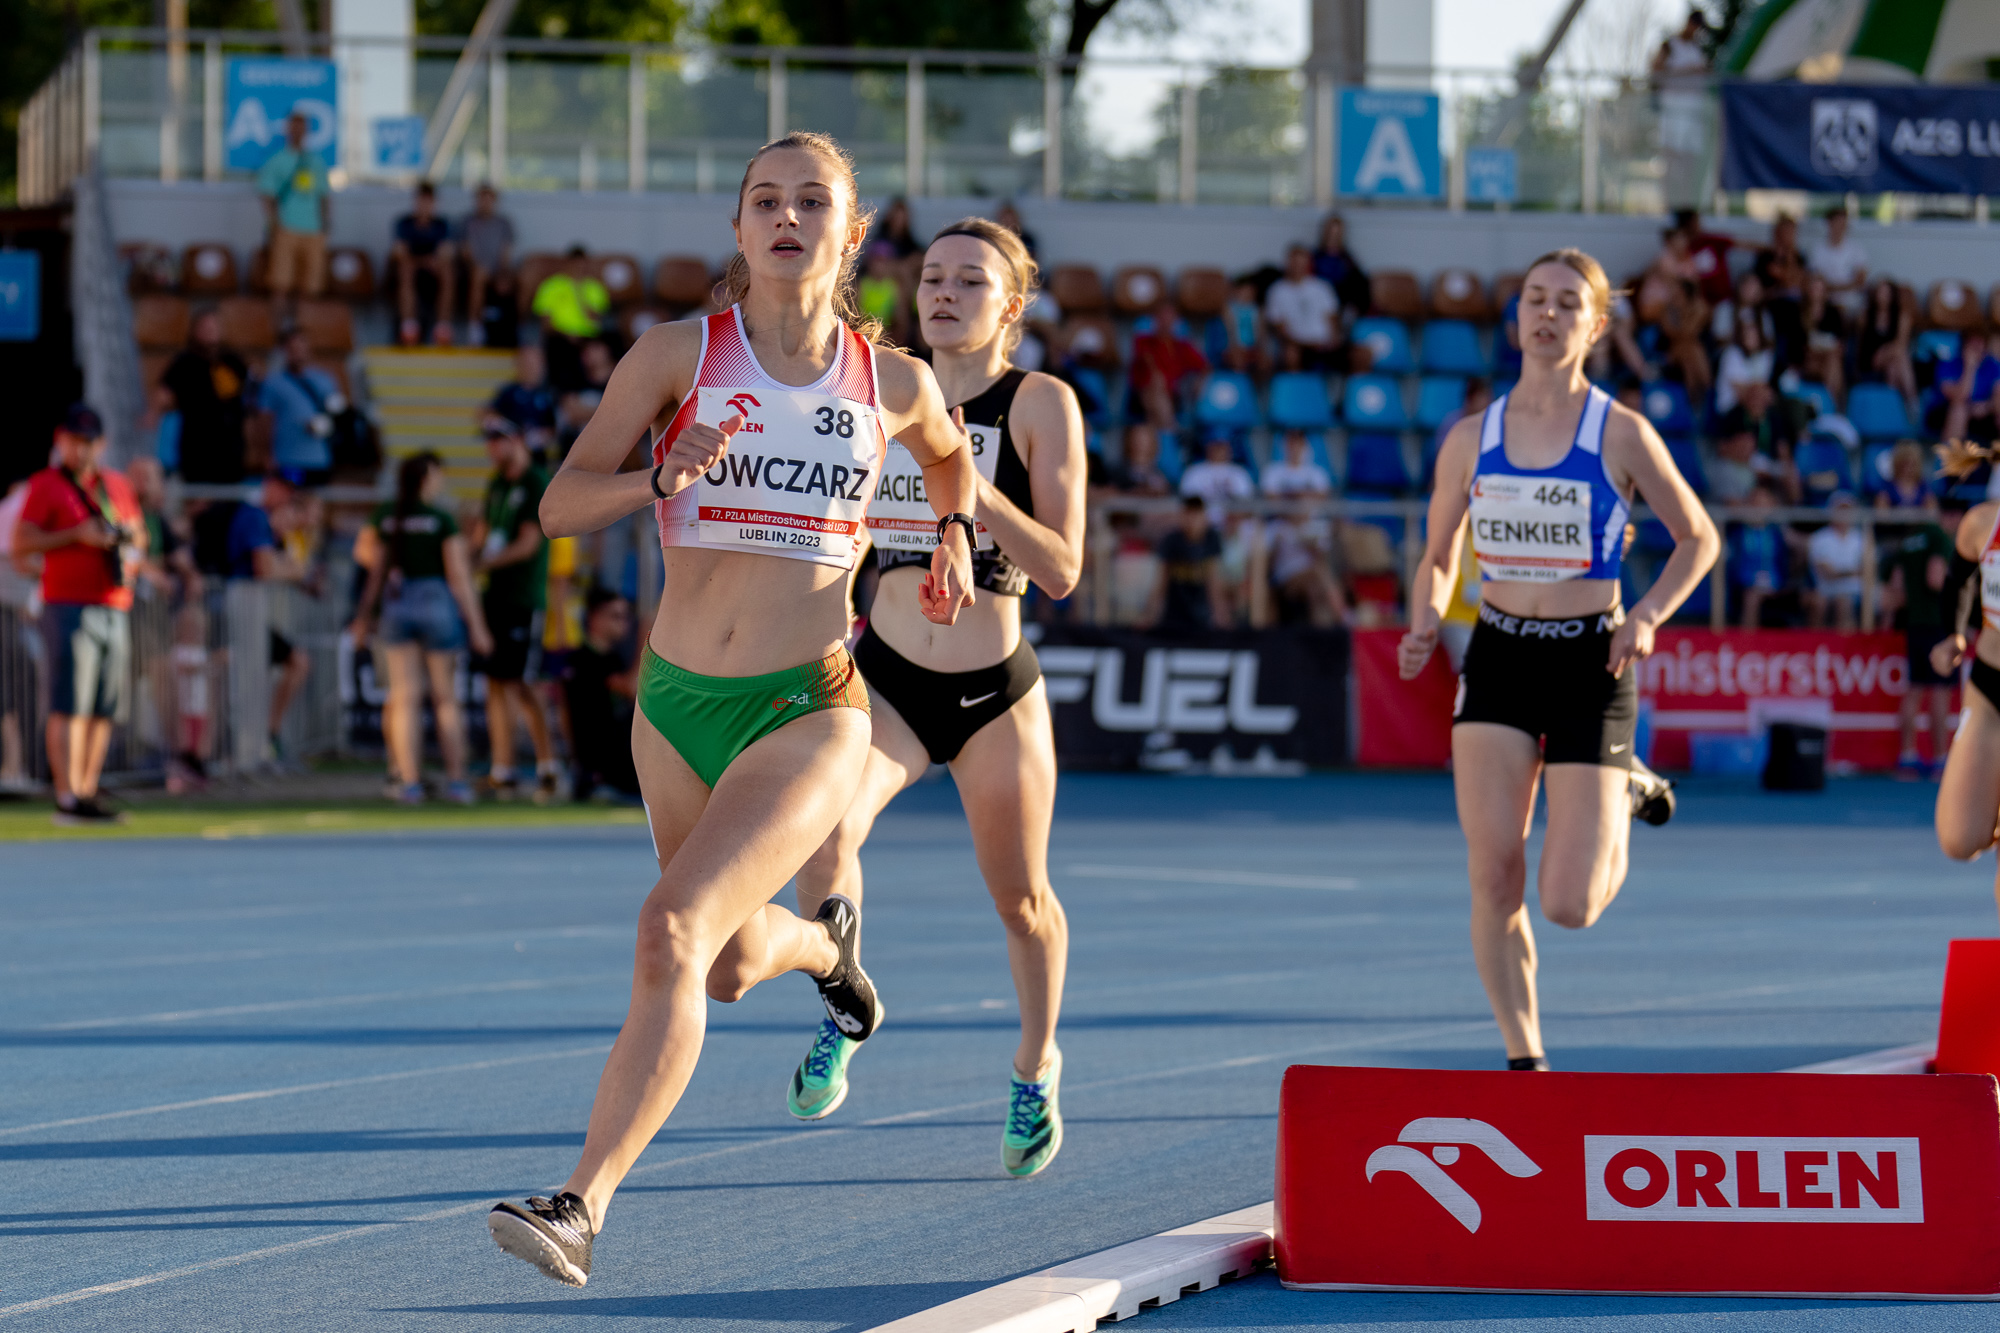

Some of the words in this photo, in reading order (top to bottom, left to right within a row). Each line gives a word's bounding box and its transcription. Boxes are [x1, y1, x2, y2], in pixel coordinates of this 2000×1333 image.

[1891, 117, 1962, 156] AZS
[1354, 117, 1426, 190] A
[814, 406, 854, 438] 38
[704, 453, 869, 501] OWCZARZ
[874, 474, 928, 502] ACIE
[1533, 485, 1577, 506] 464
[710, 509, 723, 519] 77.
[725, 510, 746, 521] PZLA
[747, 512, 808, 528] Mistrzostwa
[809, 519, 834, 531] Polski
[834, 521, 849, 533] U20
[868, 518, 878, 528] 77.
[878, 519, 895, 529] PZLA
[896, 521, 938, 531] Mistrzostwa
[1477, 518, 1581, 546] CENKIER
[739, 528, 787, 543] LUBLIN
[789, 532, 821, 548] 2023
[888, 534, 922, 545] LUBLIN
[925, 536, 940, 546] 20
[1520, 618, 1585, 640] PRO
[1038, 647, 1298, 734] FUEL
[1603, 1147, 1901, 1209] ORLEN
